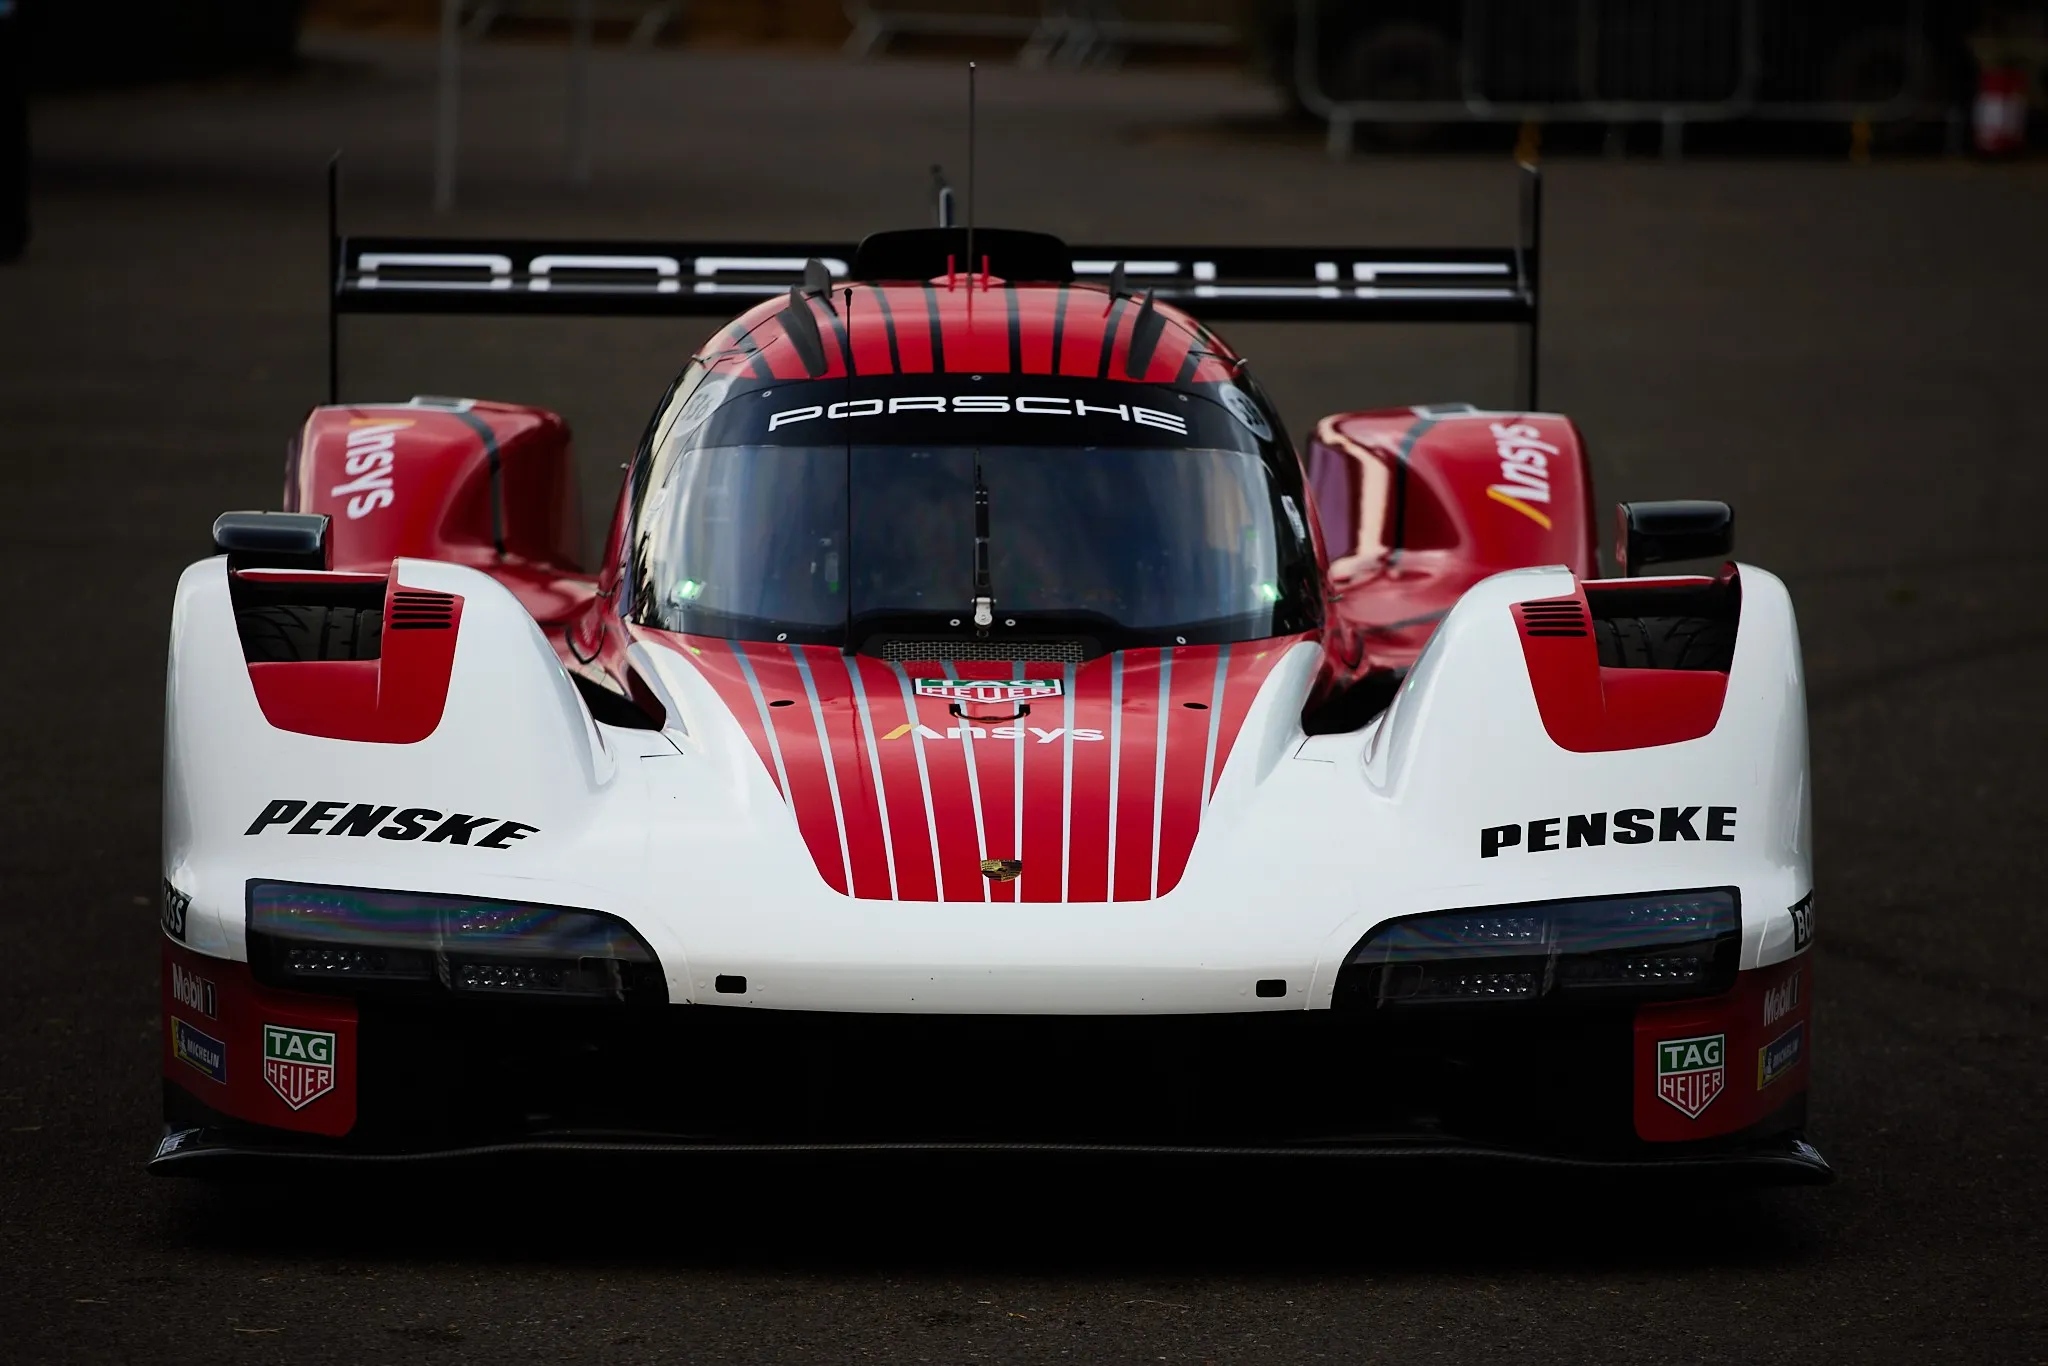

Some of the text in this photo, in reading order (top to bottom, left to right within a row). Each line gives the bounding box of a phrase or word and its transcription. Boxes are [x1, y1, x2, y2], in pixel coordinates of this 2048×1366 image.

[768, 395, 1188, 436] PORSCHE
[331, 418, 416, 519] Ansys
[1486, 423, 1560, 530] Ansys
[926, 687, 1051, 700] HEUER
[881, 724, 1105, 744] Ansys
[244, 799, 541, 849] PENSKE
[1480, 806, 1737, 859] PENSKE
[172, 962, 203, 1013] Mobil
[1763, 976, 1793, 1027] Mobil
[187, 1038, 220, 1069] MICHELIN
[269, 1031, 328, 1061] TAG
[1664, 1041, 1720, 1069] TAG
[267, 1062, 329, 1103] HEUER
[1663, 1071, 1721, 1111] HEUER
